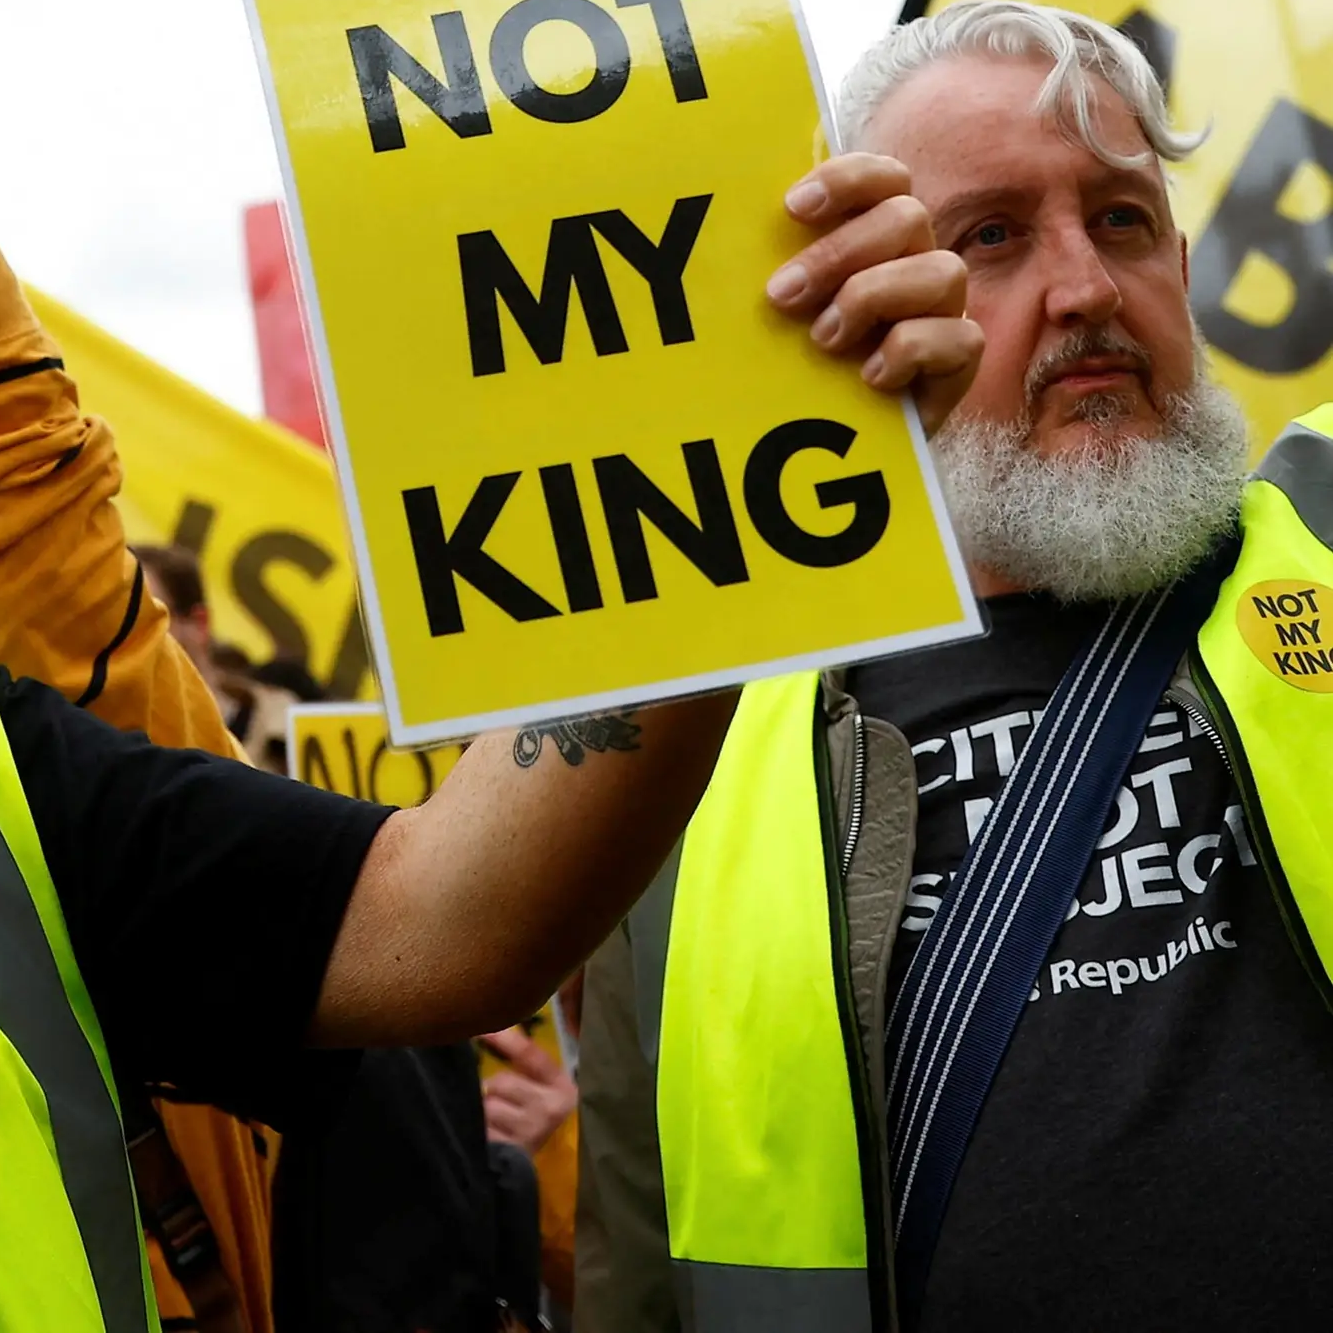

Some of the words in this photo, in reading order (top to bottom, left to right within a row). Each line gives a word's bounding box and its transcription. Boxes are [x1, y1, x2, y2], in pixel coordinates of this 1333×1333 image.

[456, 193, 714, 378] MY
[402, 418, 891, 638] KING
[1251, 588, 1319, 619] NOT
[1274, 619, 1321, 647] MY
[1272, 647, 1333, 676] KIN
[303, 728, 473, 808] NO
[1049, 916, 1238, 995] Republic
